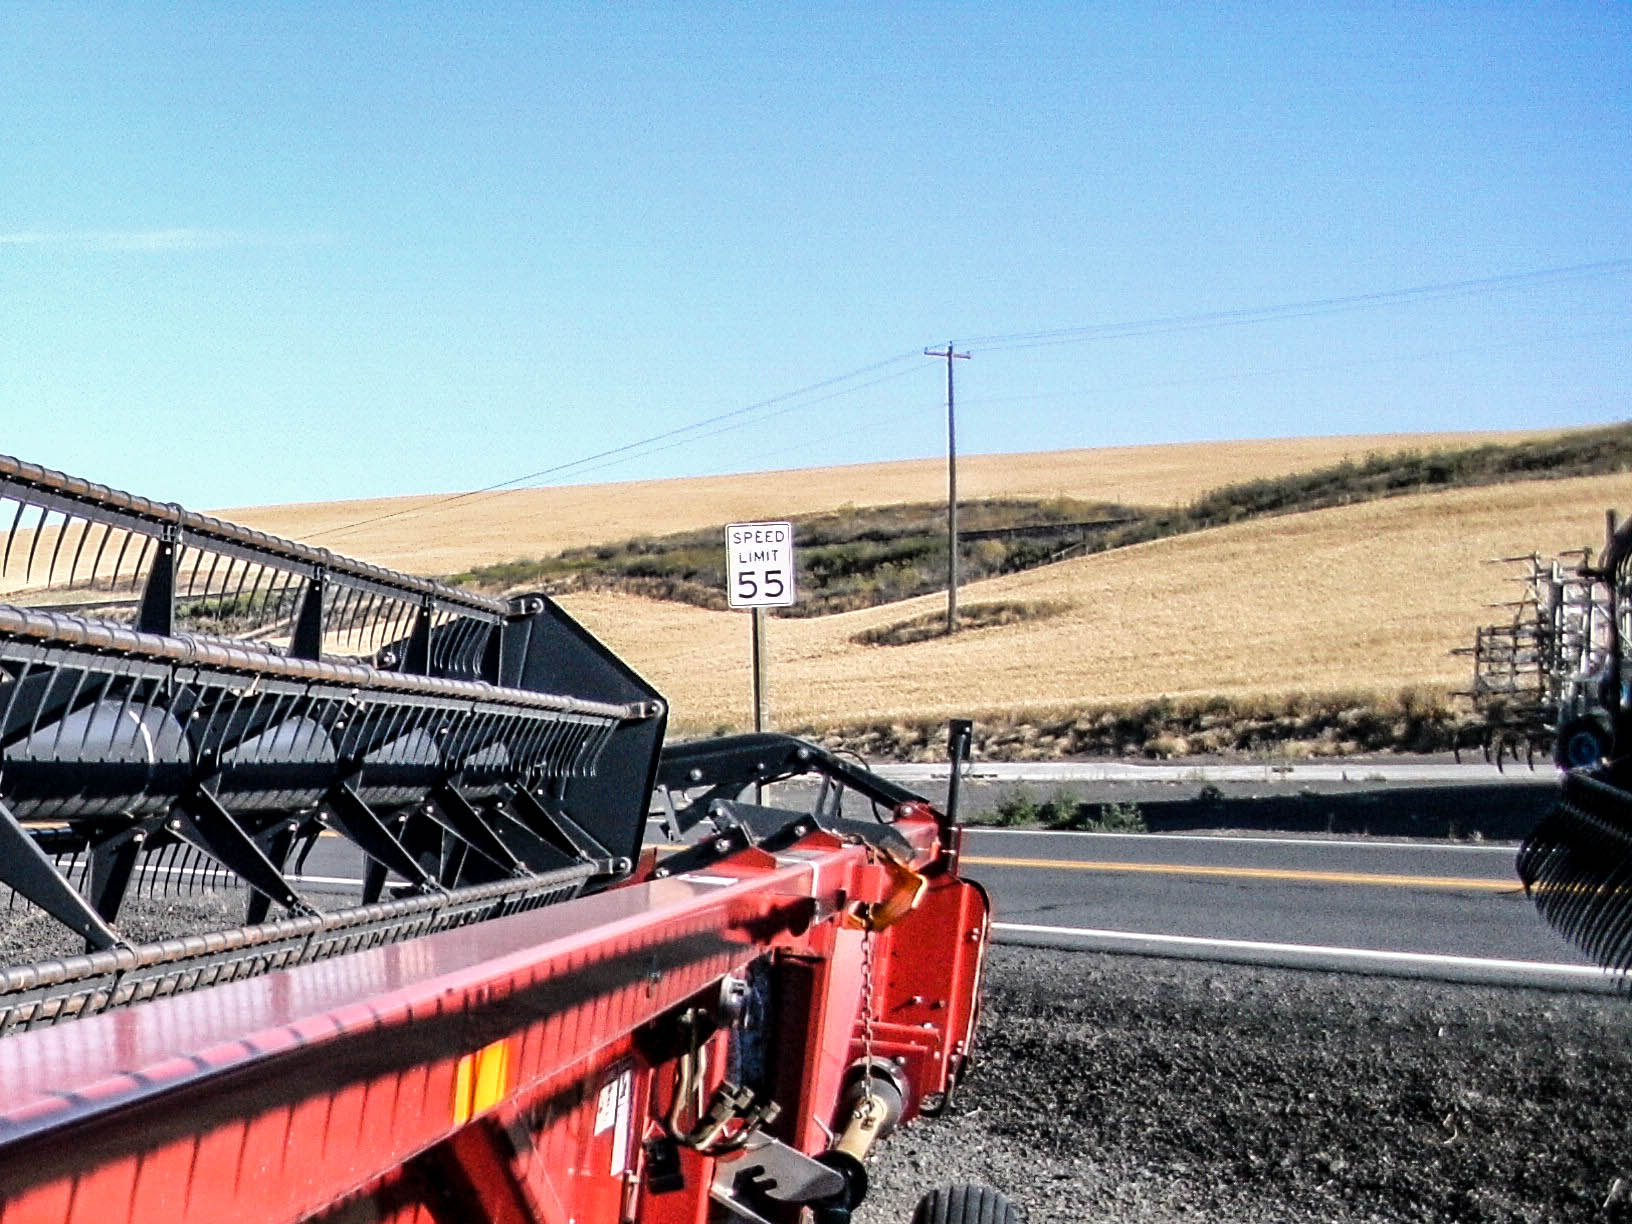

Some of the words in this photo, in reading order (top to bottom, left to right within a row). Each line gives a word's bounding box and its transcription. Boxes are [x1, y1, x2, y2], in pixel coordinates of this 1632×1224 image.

[733, 530, 784, 544] SPEED
[739, 550, 778, 563] LIMIT
[738, 570, 784, 599] 55
